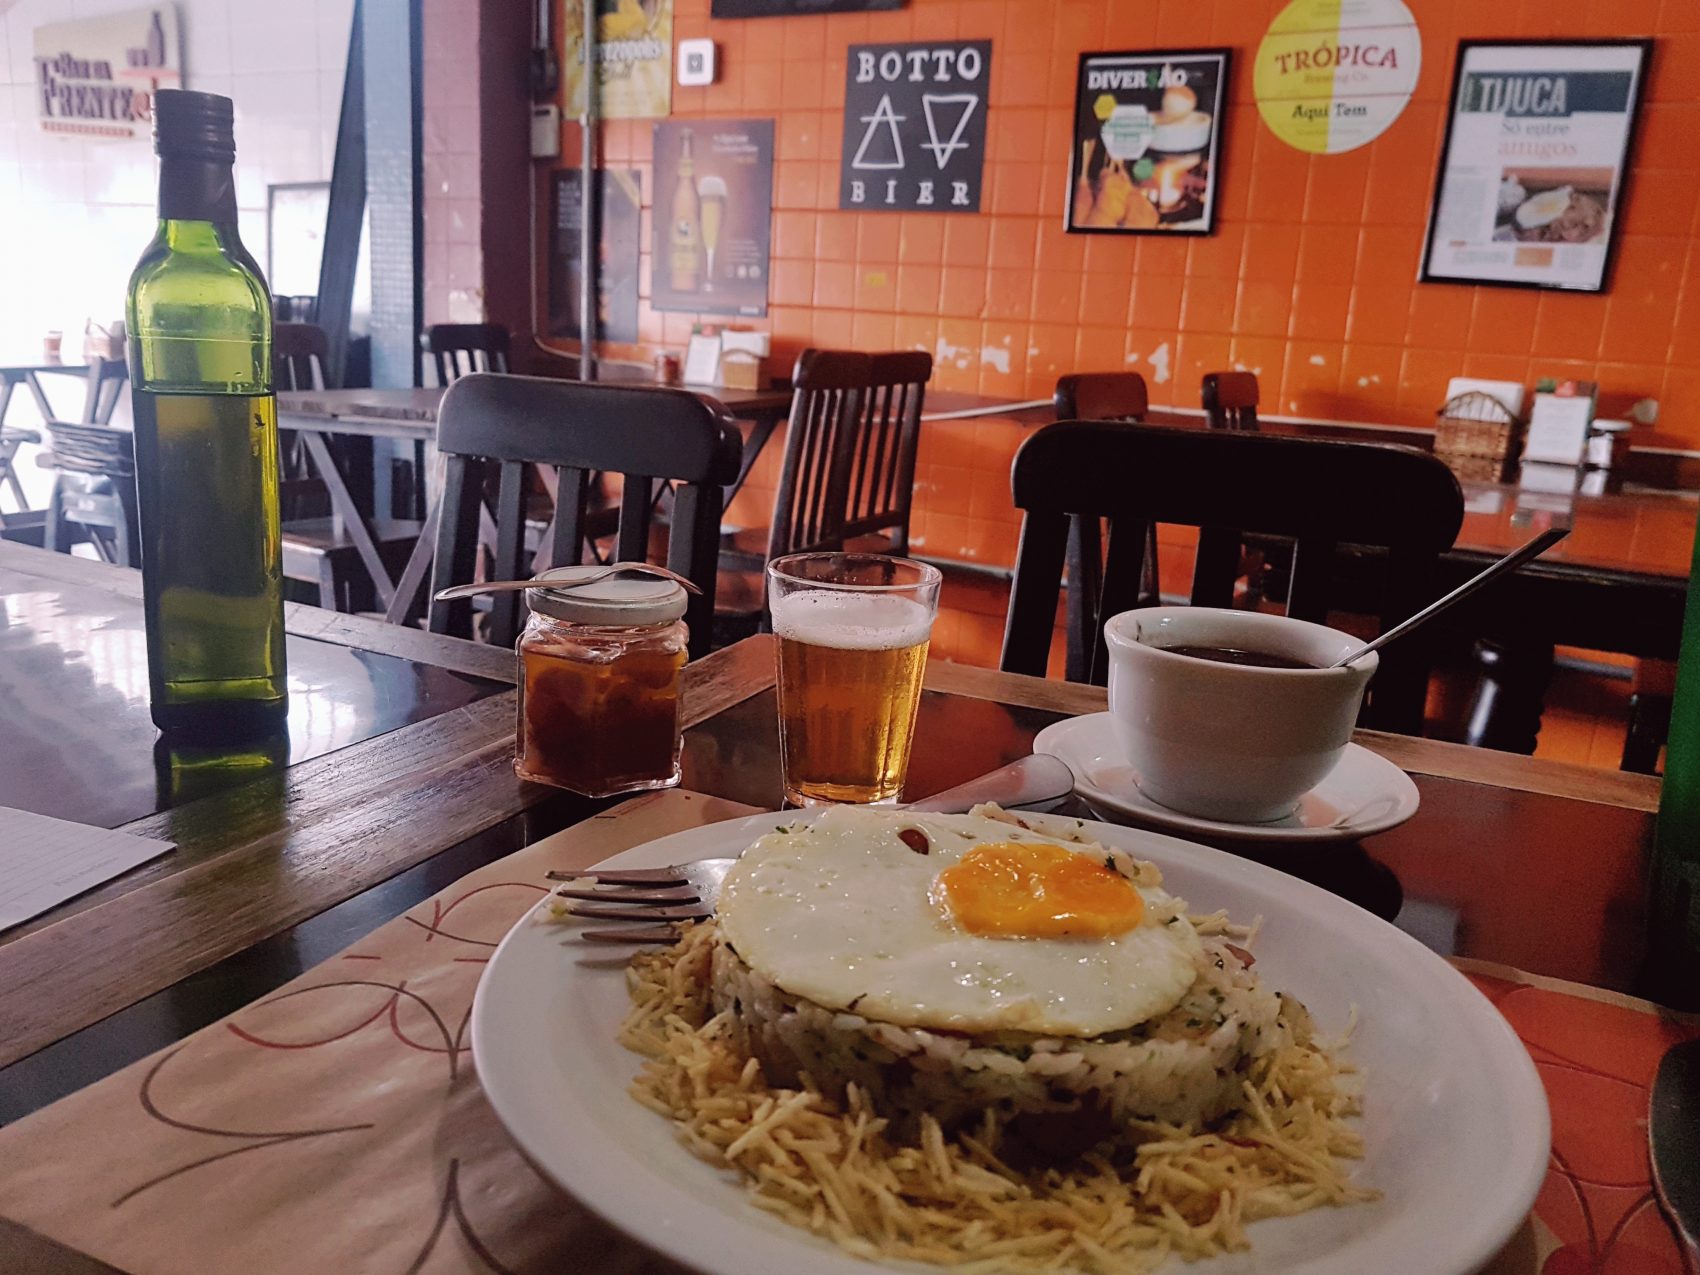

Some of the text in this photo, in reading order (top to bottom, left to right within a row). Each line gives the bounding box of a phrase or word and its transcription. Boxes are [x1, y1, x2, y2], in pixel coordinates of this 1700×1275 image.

[855, 46, 982, 84] BOTTO
[1275, 40, 1399, 75] TRÓPICA
[1479, 76, 1568, 116] TIJUCA
[1291, 102, 1368, 122] Aqui Tem
[1526, 121, 1571, 137] entre
[850, 179, 970, 206] BIER
